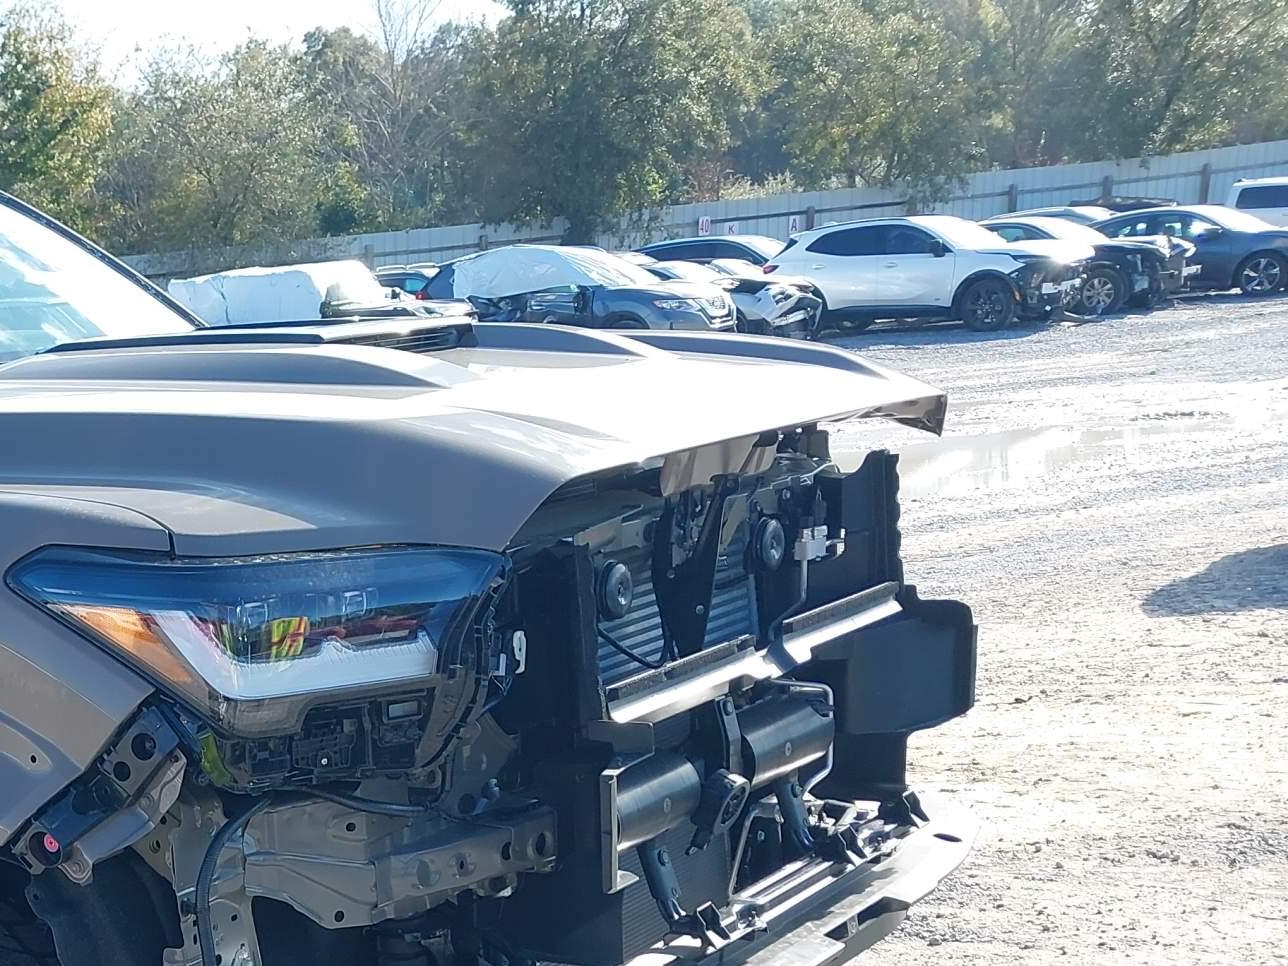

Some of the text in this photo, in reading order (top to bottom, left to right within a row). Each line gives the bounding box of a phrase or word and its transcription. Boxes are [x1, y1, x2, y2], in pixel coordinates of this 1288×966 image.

[699, 219, 710, 233] 40
[728, 224, 735, 234] K
[791, 217, 798, 232] A
